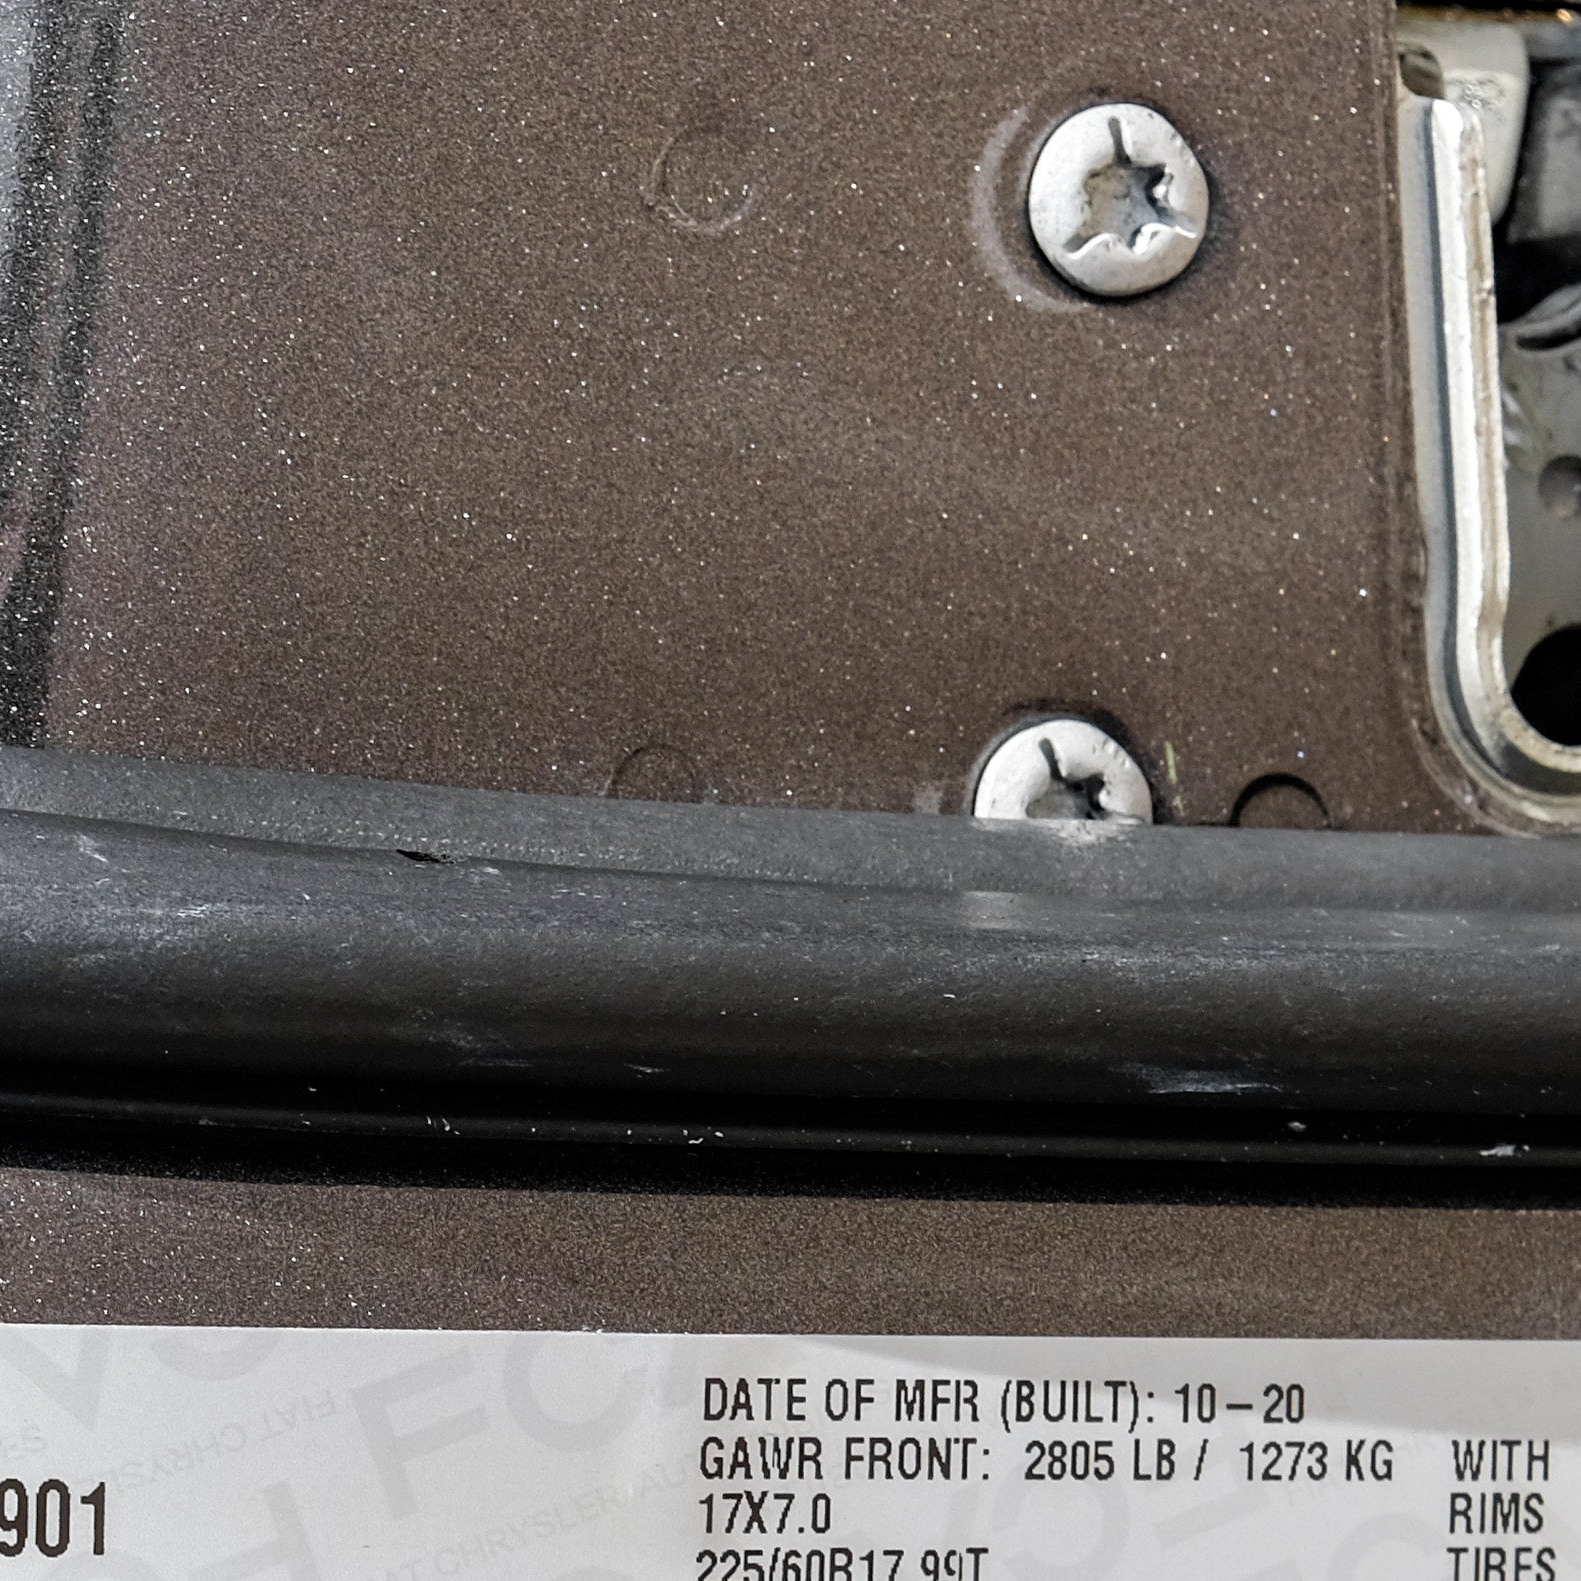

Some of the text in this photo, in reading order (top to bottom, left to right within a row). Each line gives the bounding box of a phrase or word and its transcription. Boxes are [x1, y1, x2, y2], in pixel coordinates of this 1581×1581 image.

[704, 1378, 806, 1421] DATE
[826, 1379, 874, 1421] OF
[896, 1379, 979, 1422] MFR
[1001, 1380, 1154, 1433] (BUILT):
[700, 1437, 823, 1479] GAWR
[845, 1437, 989, 1480] FRONT:
[1025, 1441, 1114, 1480] 2805
[1134, 1439, 1175, 1480] LB
[1240, 1442, 1327, 1480] 1273
[1346, 1440, 1393, 1481] KG
[1452, 1440, 1549, 1481] WITH
[699, 1490, 830, 1533] 17X7.0
[1450, 1493, 1543, 1533] RIMS
